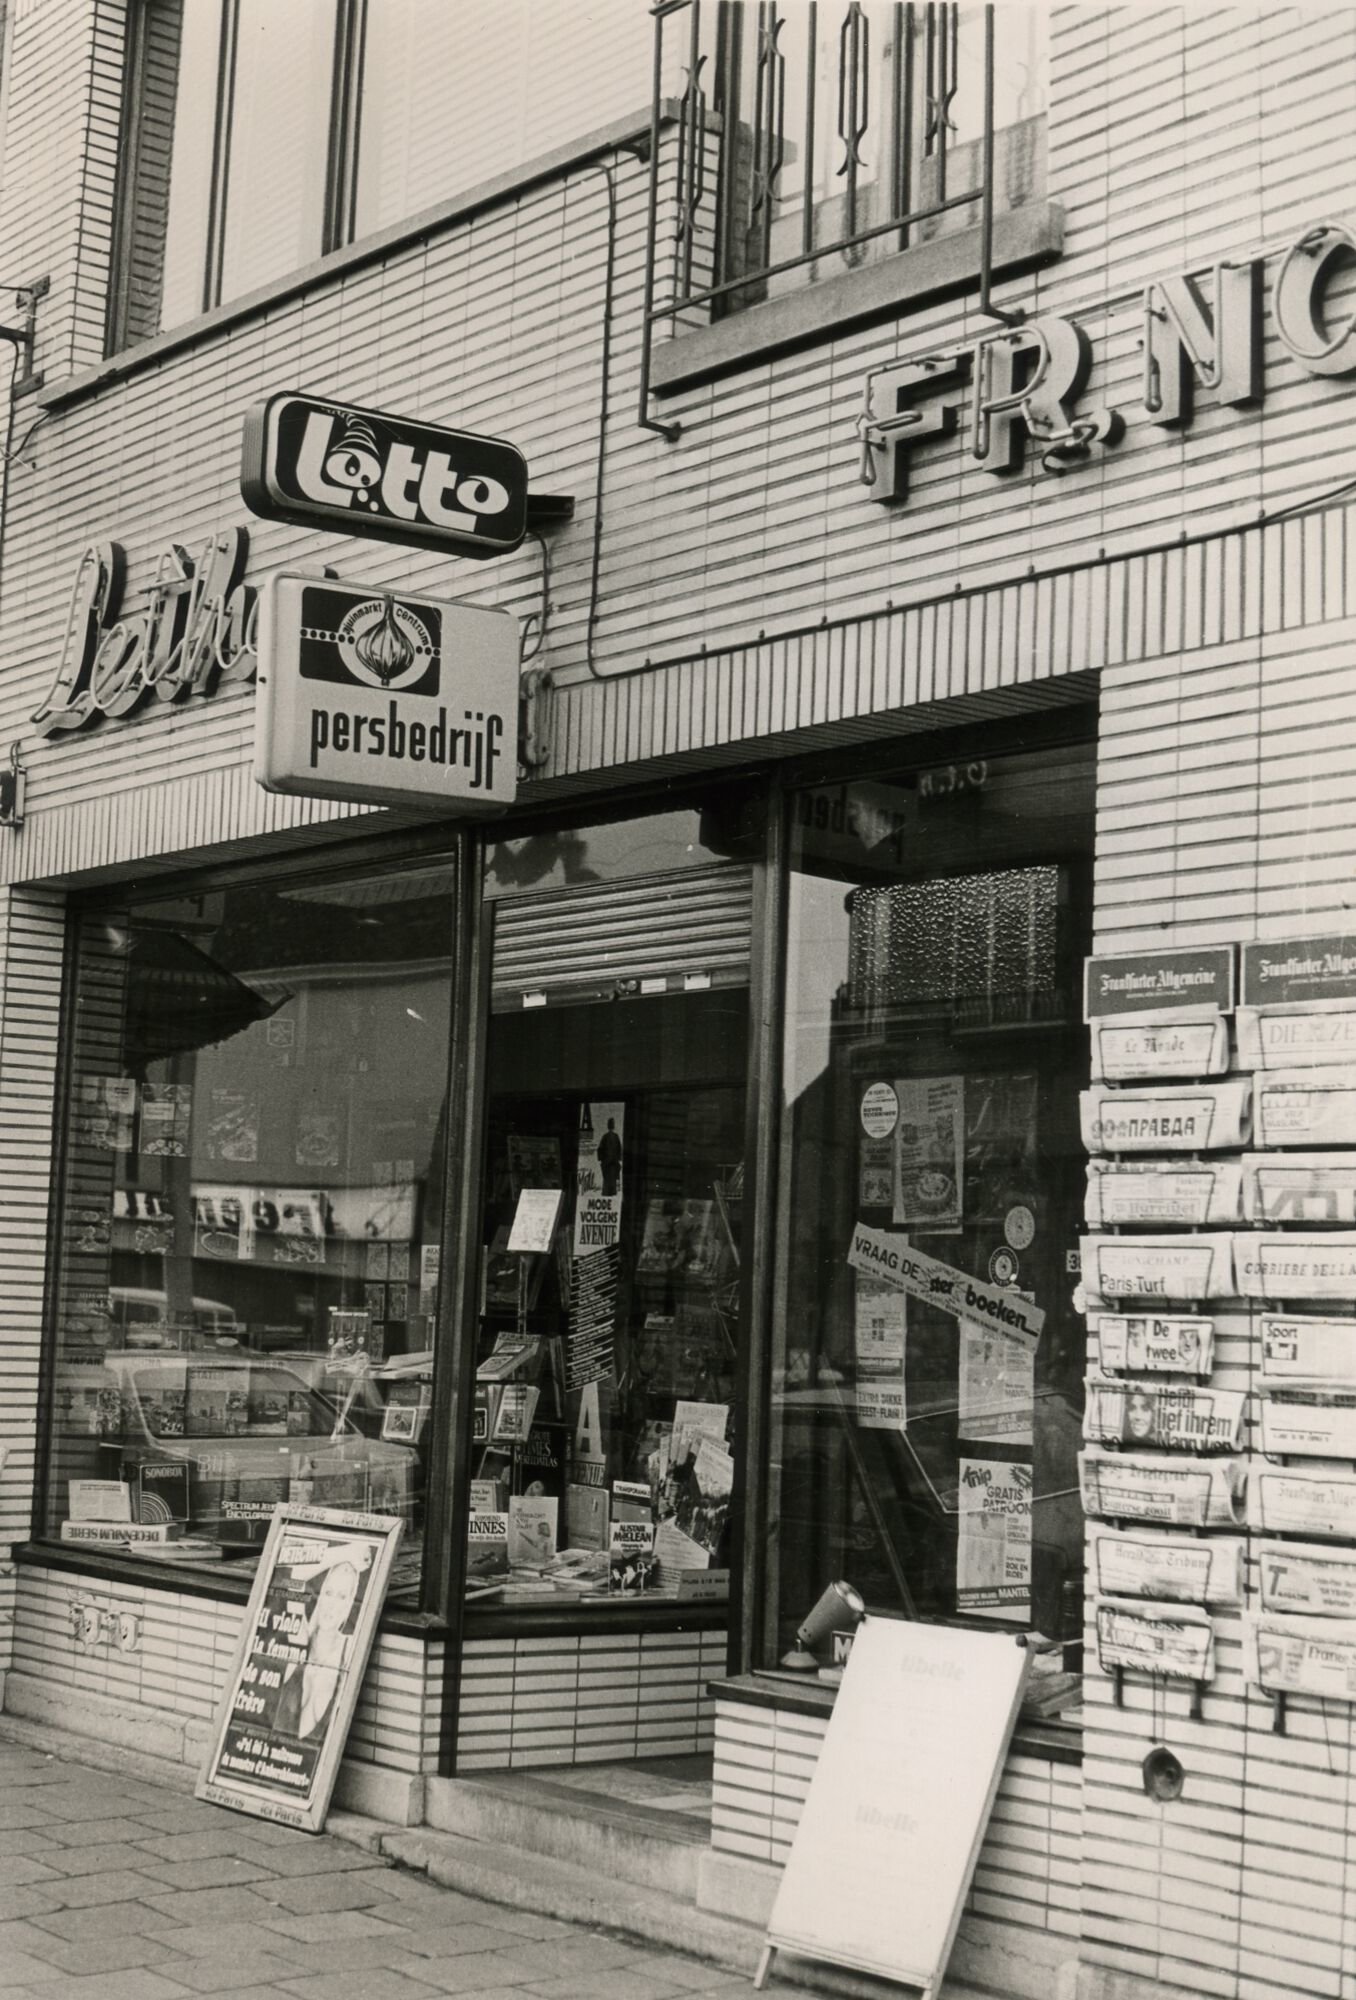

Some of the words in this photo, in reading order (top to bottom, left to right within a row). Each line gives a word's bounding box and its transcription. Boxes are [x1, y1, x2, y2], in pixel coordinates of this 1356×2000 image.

[297, 411, 510, 532] Lotto
[342, 602, 383, 636] ajuinmarkt
[395, 607, 430, 647] centrum
[310, 699, 504, 790] persbedrijf
[1155, 966, 1216, 990] Allgemeine
[1127, 1116, 1195, 1138] ПРАВДА
[587, 1198, 612, 1211] MODE
[580, 1211, 618, 1224] VOLGENS
[579, 1224, 617, 1246] AVENUE
[855, 1236, 899, 1270] VRAAG
[902, 1259, 921, 1280] DE
[929, 1276, 955, 1294] ster
[965, 1284, 1039, 1337] boeken
[1100, 1273, 1166, 1293] Paris-Turf
[1153, 1321, 1170, 1338] De
[1266, 1323, 1298, 1338] Sport
[1145, 1344, 1177, 1361] twee
[1184, 1409, 1232, 1437] ihrem
[986, 1486, 1024, 1502] GRATIS
[68, 1526, 97, 1540] SERIE
[99, 1528, 159, 1542] DECENNIUM
[468, 1521, 506, 1534] INNES
[999, 1586, 1031, 1598] MANTEL
[258, 1669, 281, 1689] son
